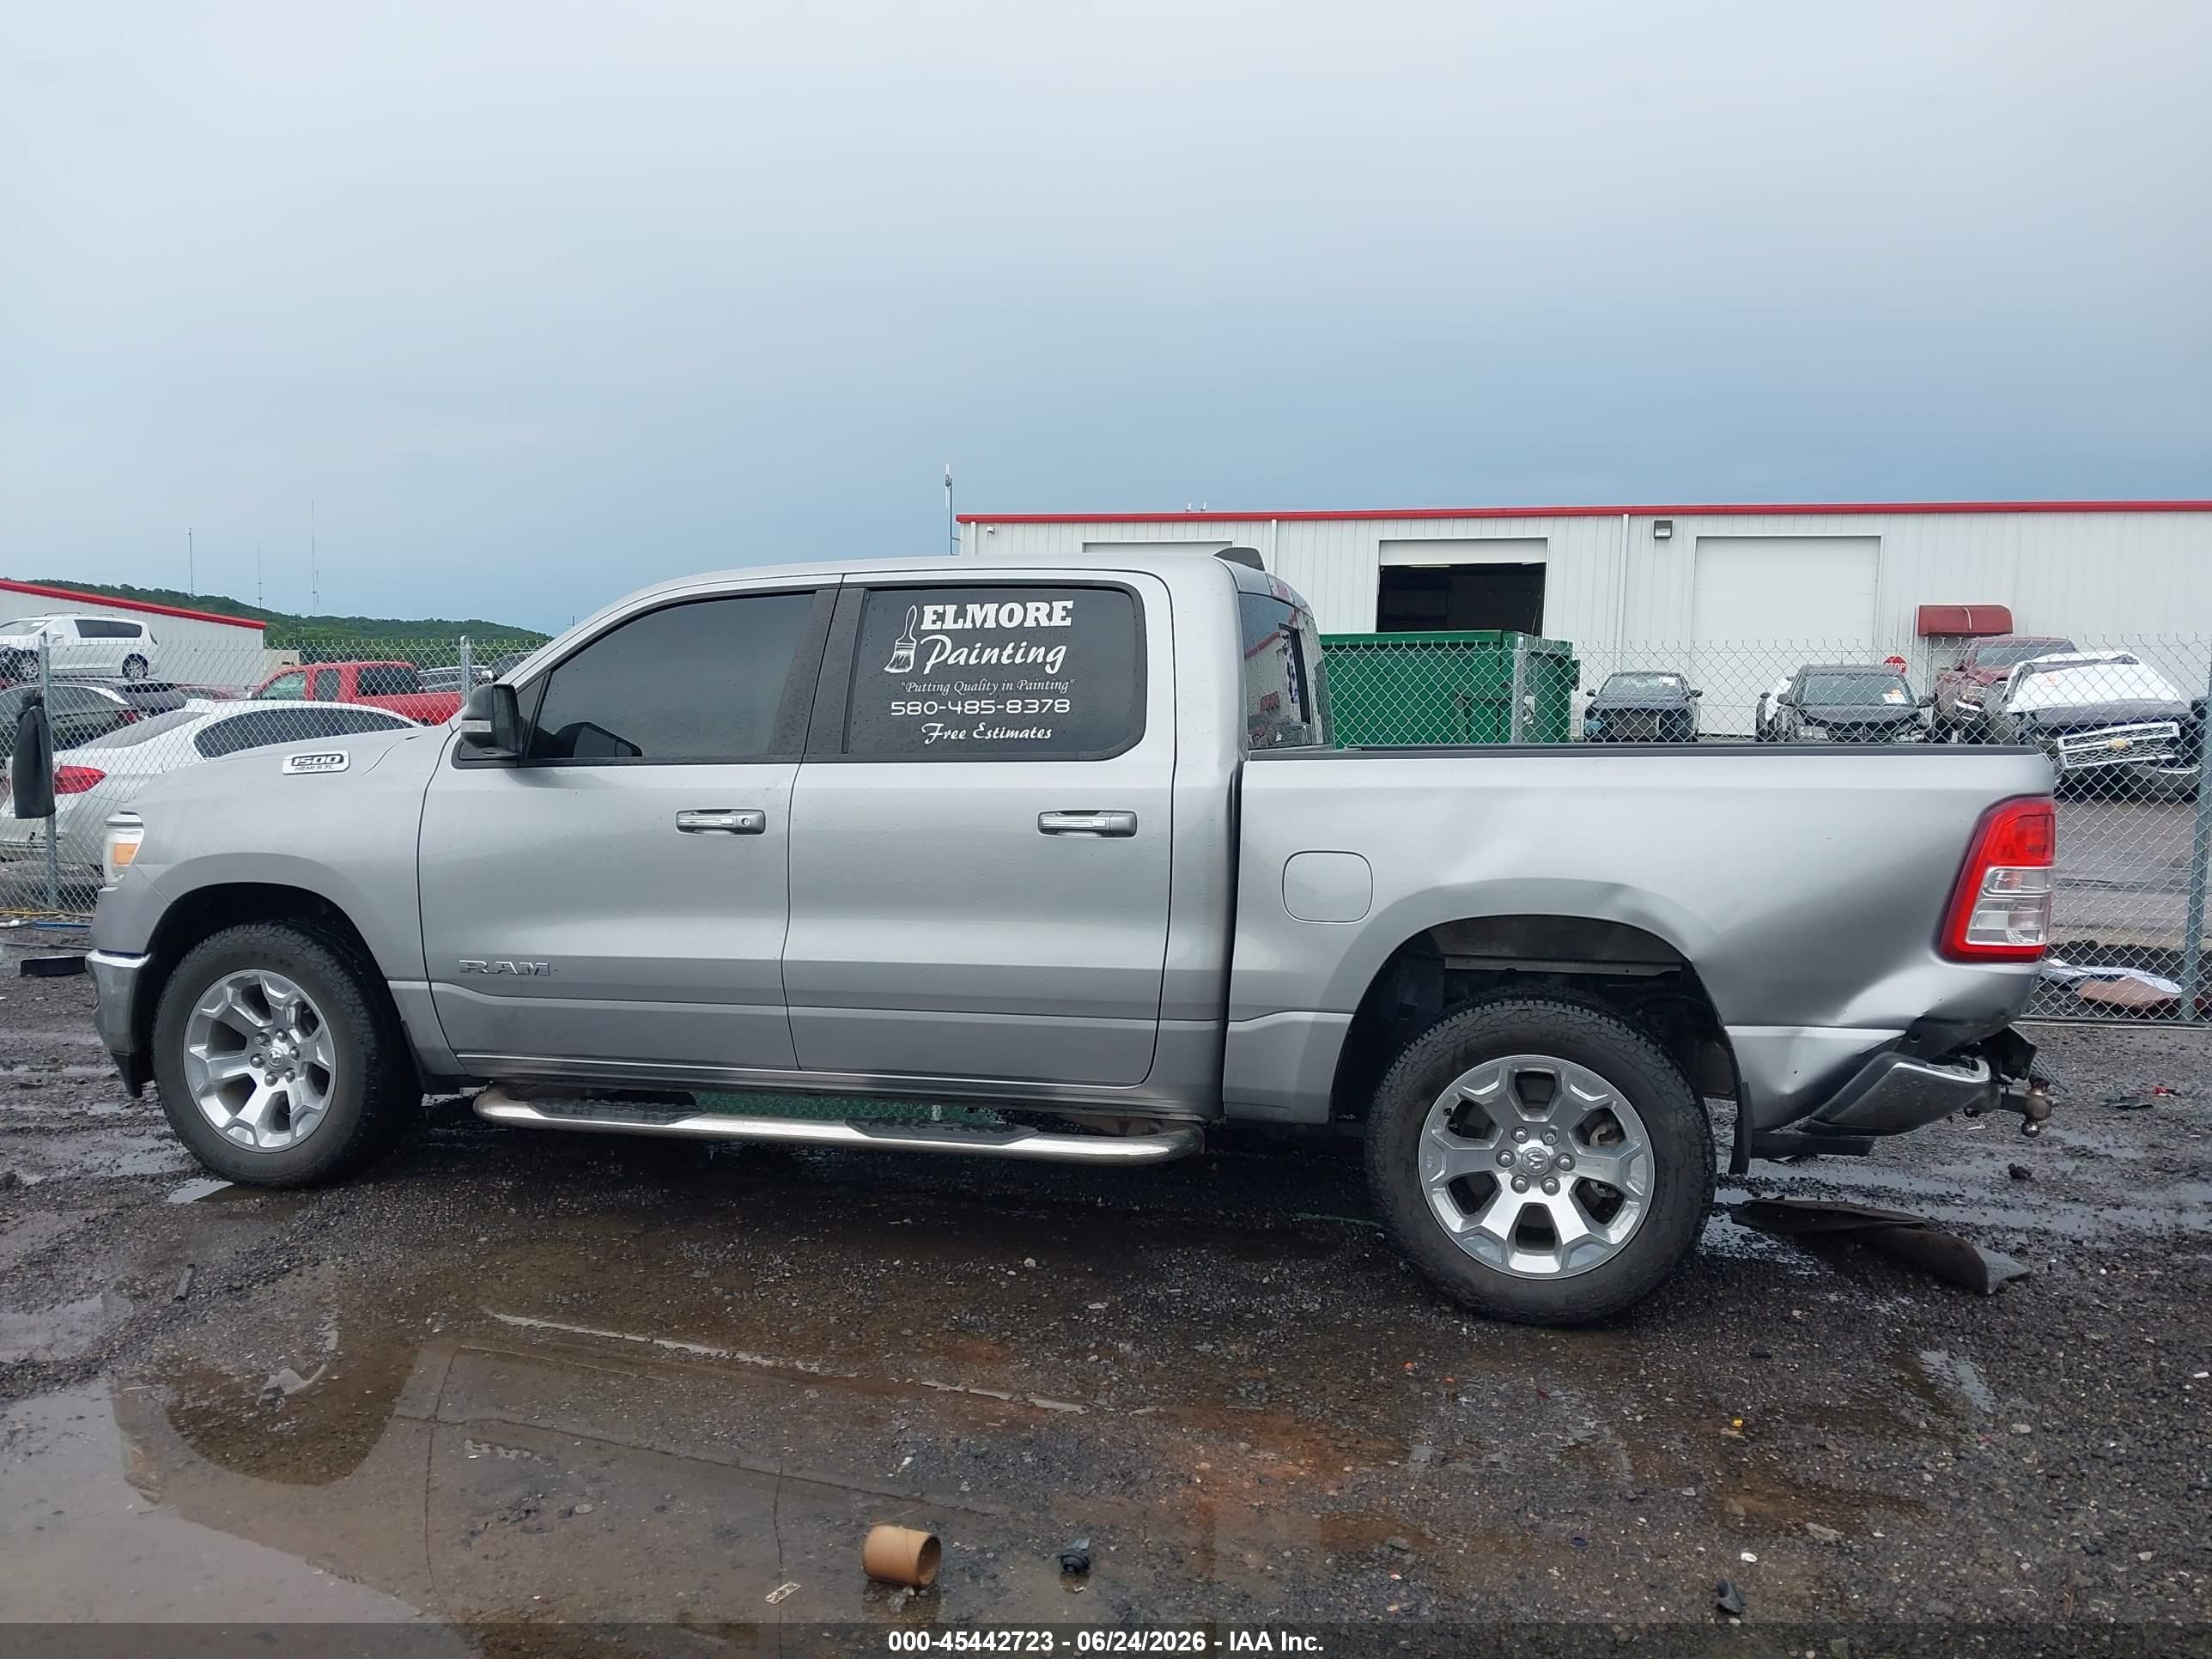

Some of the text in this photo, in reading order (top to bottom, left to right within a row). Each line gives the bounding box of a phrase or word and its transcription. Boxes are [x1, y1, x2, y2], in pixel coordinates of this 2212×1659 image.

[921, 599, 1074, 630] ELMORE
[920, 634, 1067, 675] Painting
[901, 678, 1075, 696] "Putting Quality in Painting"
[890, 698, 1071, 716] 580-485-8378
[921, 721, 1053, 745] Free Estimates
[292, 755, 342, 765] 1500
[458, 959, 550, 976] RAM
